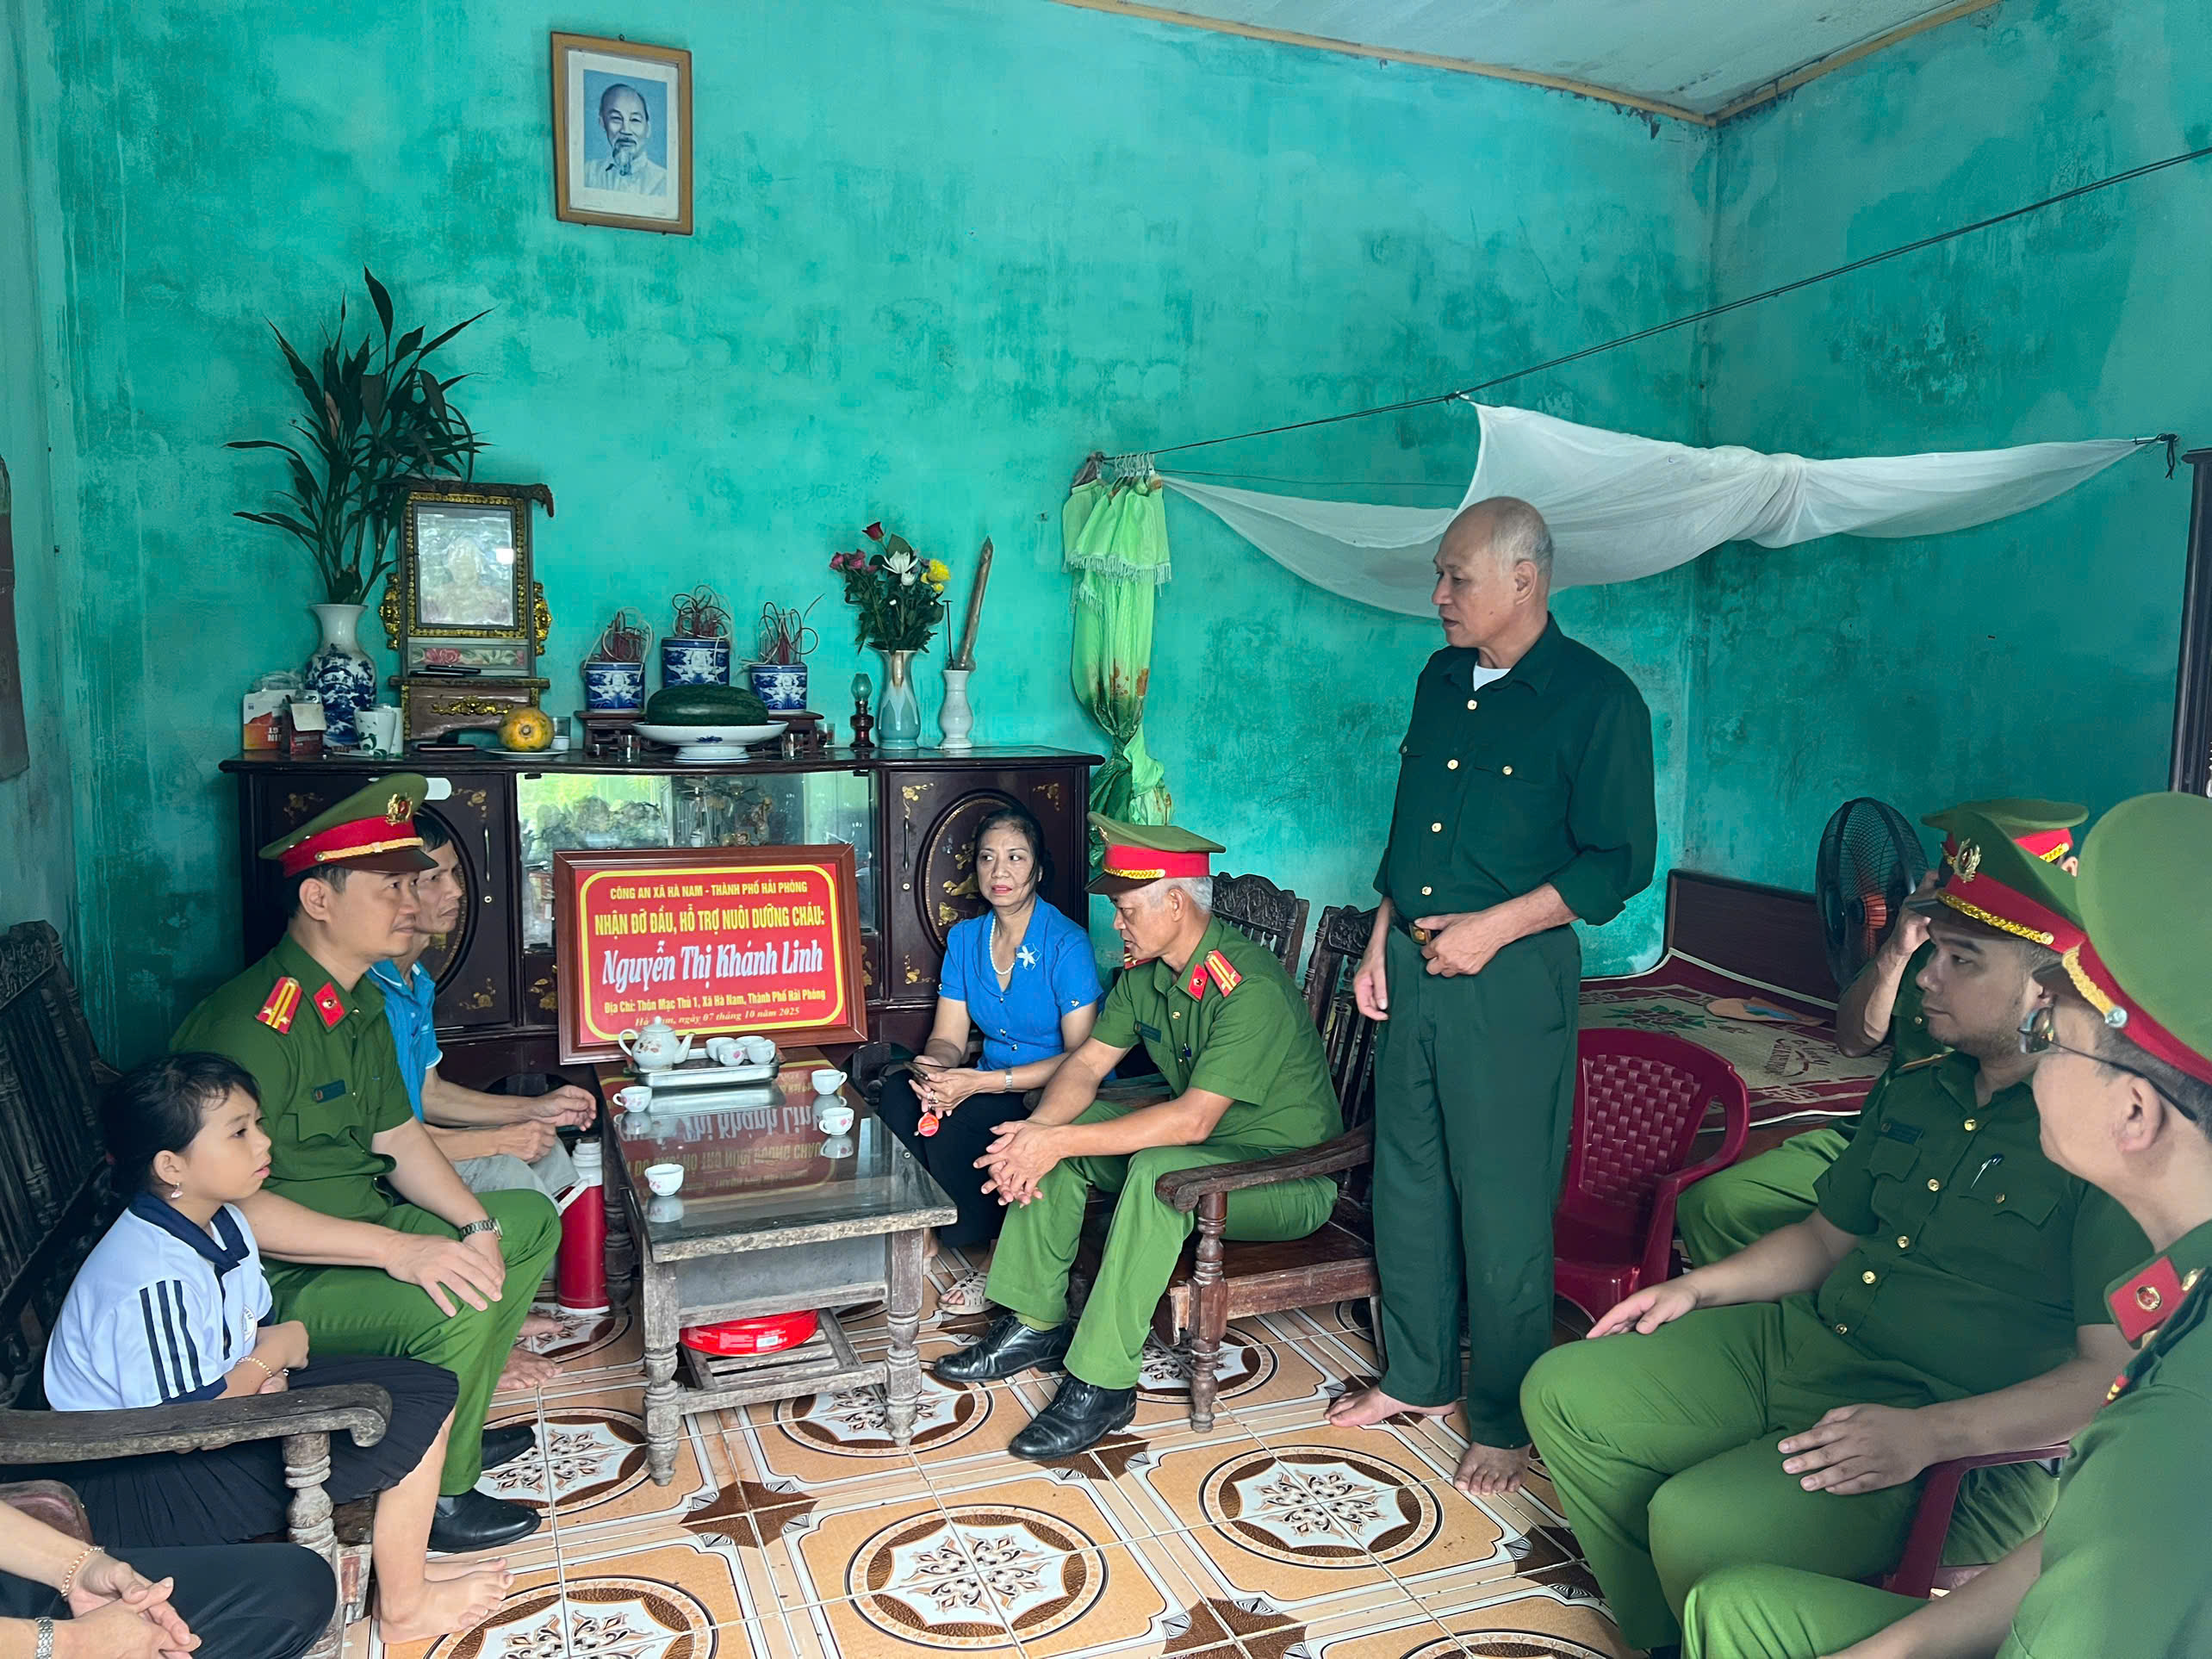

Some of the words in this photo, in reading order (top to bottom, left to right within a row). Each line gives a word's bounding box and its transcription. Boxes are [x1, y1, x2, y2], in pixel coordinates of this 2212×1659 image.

[610, 885, 636, 899] CÔNG
[637, 887, 651, 898] AN
[653, 885, 666, 898] XÃ
[668, 884, 680, 898] HÀ
[682, 885, 703, 897] NAM
[711, 882, 740, 896] THÀNH
[742, 879, 760, 895] PHỐ
[761, 879, 776, 894] HẢI
[778, 879, 807, 893] PHÒNG
[595, 910, 628, 940] NHẬN
[631, 908, 647, 934] ĐỠ
[649, 904, 677, 935] ĐẦU,
[680, 904, 695, 932] HỖ
[698, 907, 719, 935] TRỢ
[722, 904, 749, 929] NUÔI
[752, 903, 790, 929] DƯỠNG
[792, 901, 825, 928] CHÁU:
[602, 940, 676, 993] Nguyễn
[680, 944, 711, 989] Thị
[716, 940, 778, 979] Khánh
[781, 939, 823, 974] Linh
[604, 1002, 618, 1016] Địa
[619, 999, 636, 1013] Chỉ:
[637, 998, 656, 1011] Thôn
[658, 998, 675, 1012] Mạc
[693, 997, 701, 1009] 1,
[702, 995, 713, 1007] Xã
[714, 994, 724, 1006] Hà
[726, 994, 747, 1006] Nam,
[748, 991, 771, 1004] Thành
[772, 989, 787, 1003] Phố
[788, 988, 801, 1002] Hải
[802, 989, 826, 1001] Phòng
[679, 1015, 699, 1025] ngày
[703, 1012, 714, 1022] 07
[716, 1011, 742, 1022] tháng
[745, 1010, 755, 1019] 10
[757, 1009, 776, 1017] năm
[779, 1006, 799, 1016] 2025
